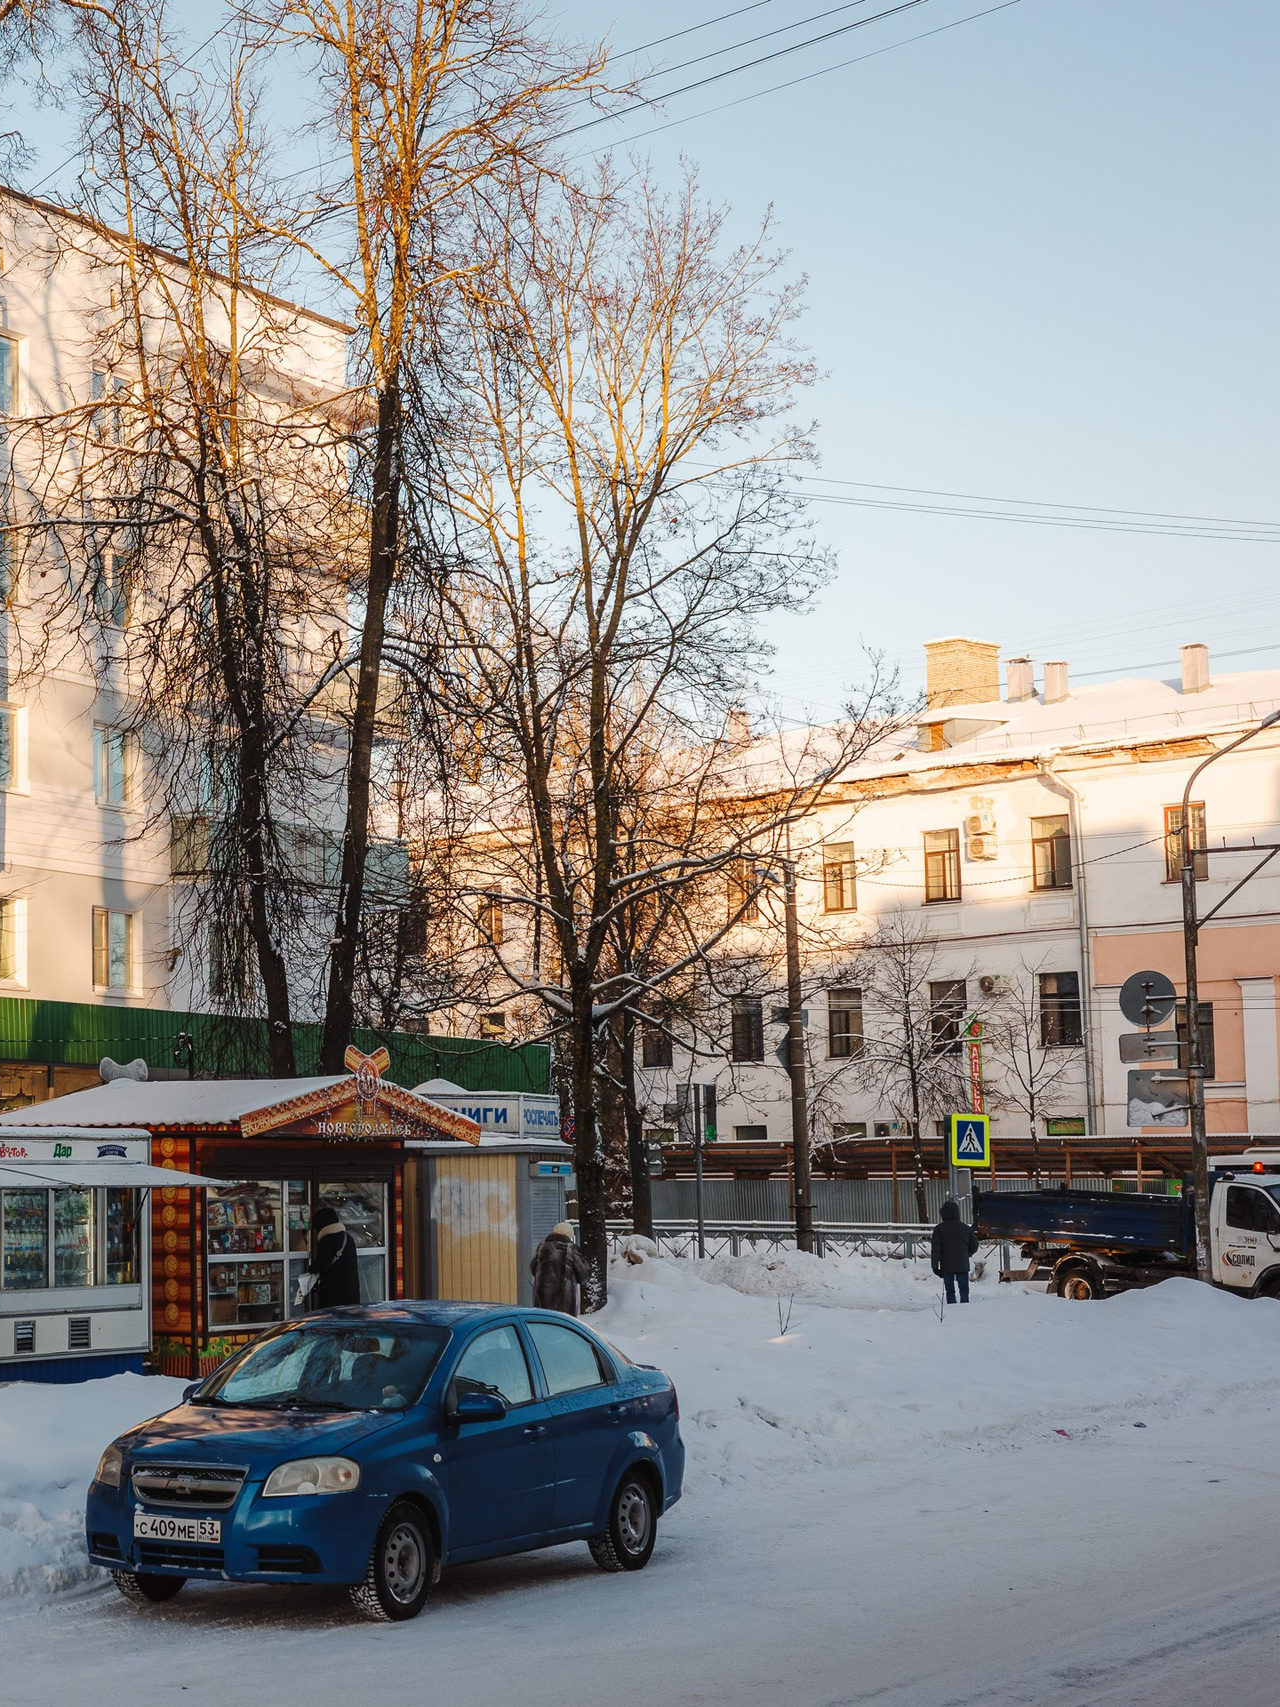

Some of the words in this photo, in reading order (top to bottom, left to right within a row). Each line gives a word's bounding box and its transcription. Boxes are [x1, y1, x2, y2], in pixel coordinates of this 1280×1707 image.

[971, 1046, 981, 1115] АПТЕК
[317, 1121, 411, 1136] НОВГОРОДХЛЕБ
[53, 1143, 72, 1158] Дар
[1232, 1254, 1255, 1267] СОЛИД
[199, 1522, 215, 1536] 53
